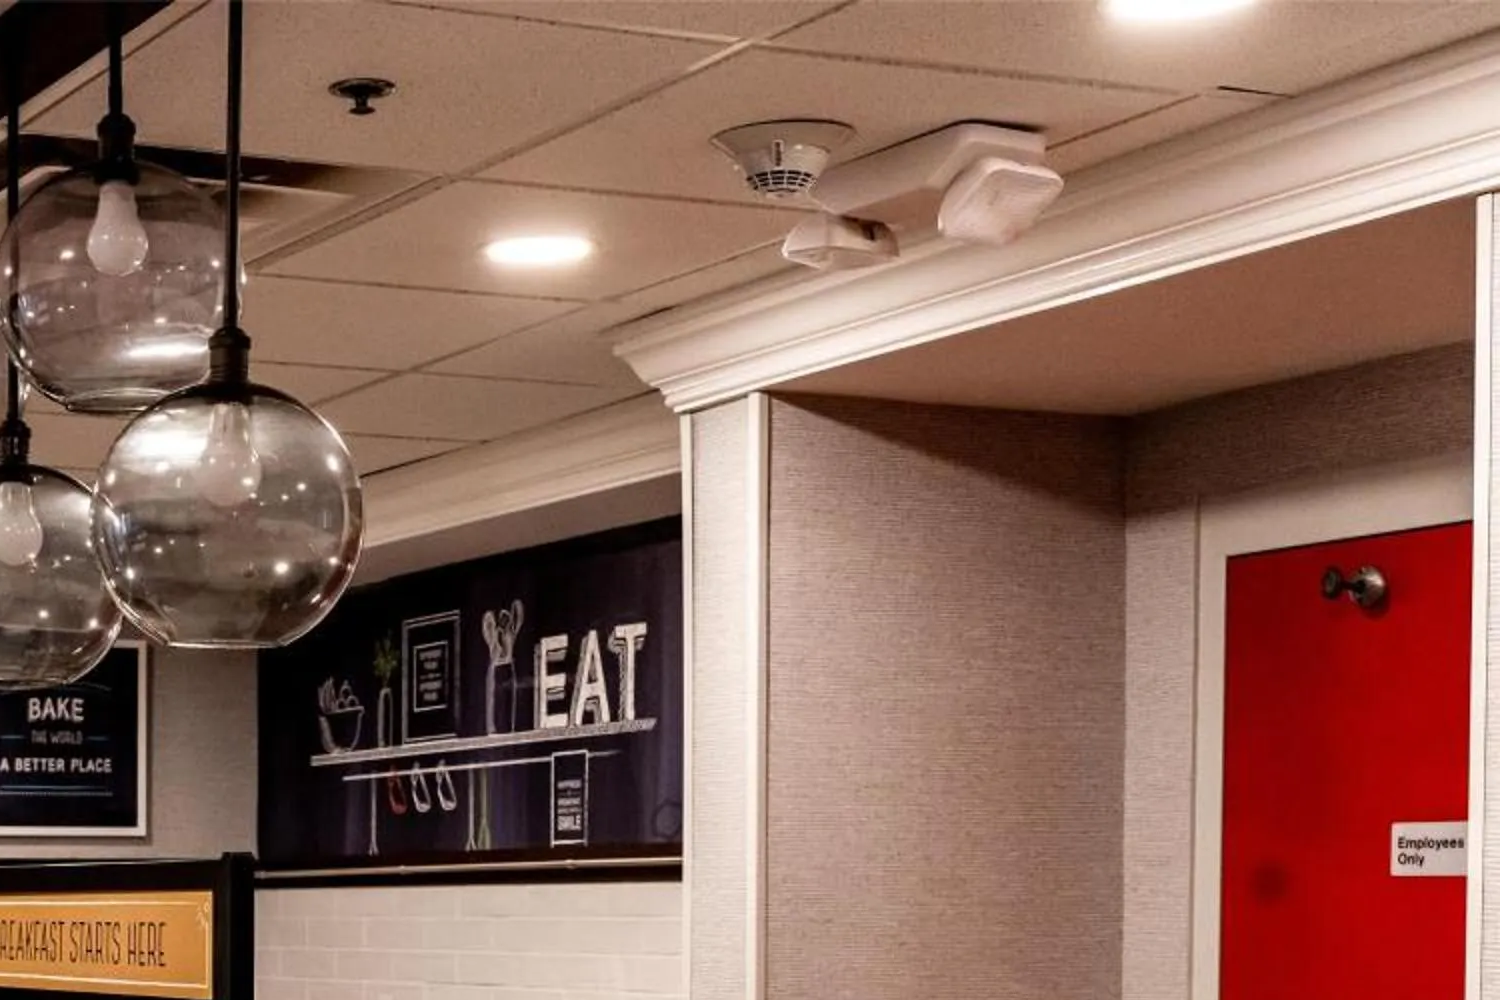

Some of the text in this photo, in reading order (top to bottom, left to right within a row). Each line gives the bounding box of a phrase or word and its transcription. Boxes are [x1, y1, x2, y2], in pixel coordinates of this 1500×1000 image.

[534, 621, 648, 729] EAT
[27, 697, 85, 722] BAKE
[31, 729, 83, 745] THE WORLD
[0, 757, 112, 773] A BETTER PLACE
[1397, 836, 1465, 851] Employees
[1397, 852, 1425, 868] Only
[69, 920, 122, 965] STARTS
[127, 921, 167, 967] HERE
